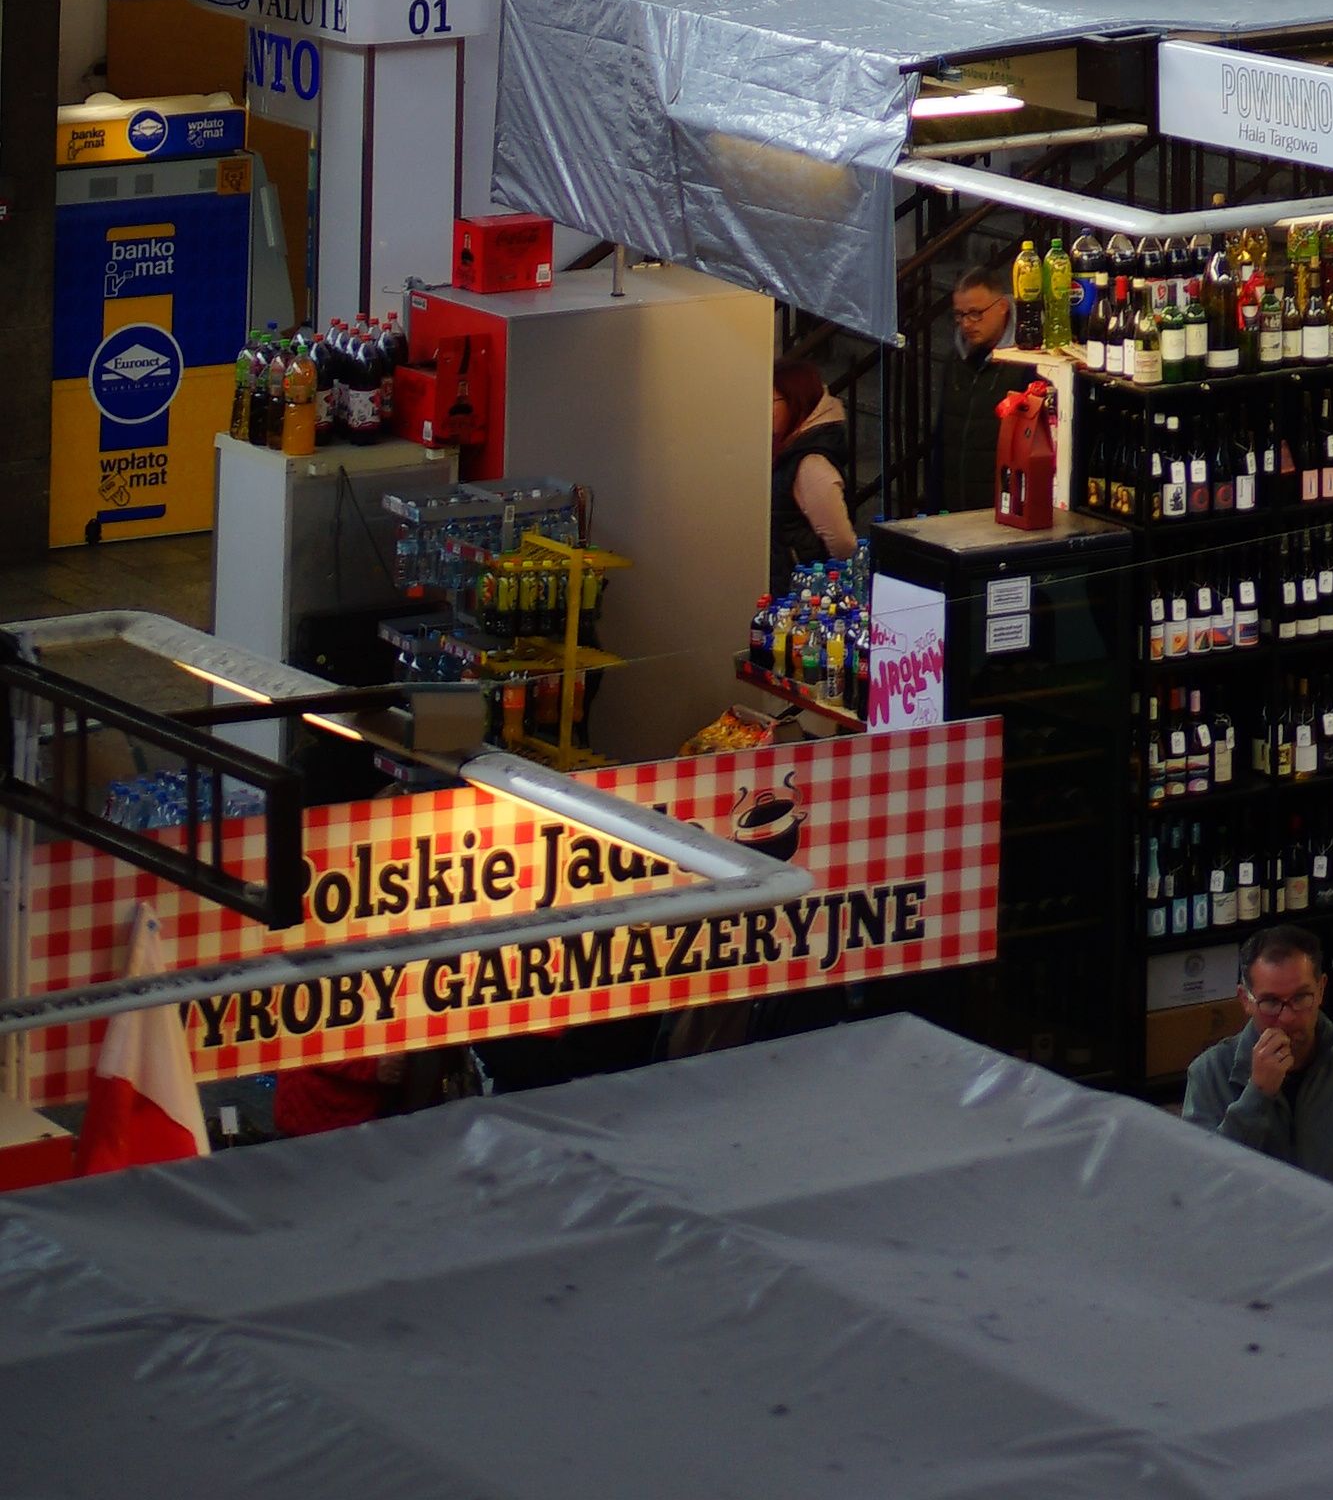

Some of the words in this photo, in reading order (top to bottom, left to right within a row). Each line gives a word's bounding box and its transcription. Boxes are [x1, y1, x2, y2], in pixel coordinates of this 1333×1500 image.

[1221, 63, 1333, 135] POWINNO
[72, 129, 106, 141] banko
[203, 128, 224, 139] mat
[1239, 122, 1266, 144] Hala
[1268, 128, 1319, 155] Targowa
[112, 239, 175, 261] banko
[135, 256, 175, 277] mat
[114, 356, 160, 370] Euronet
[101, 452, 168, 474] wpłato
[129, 469, 168, 487] mat
